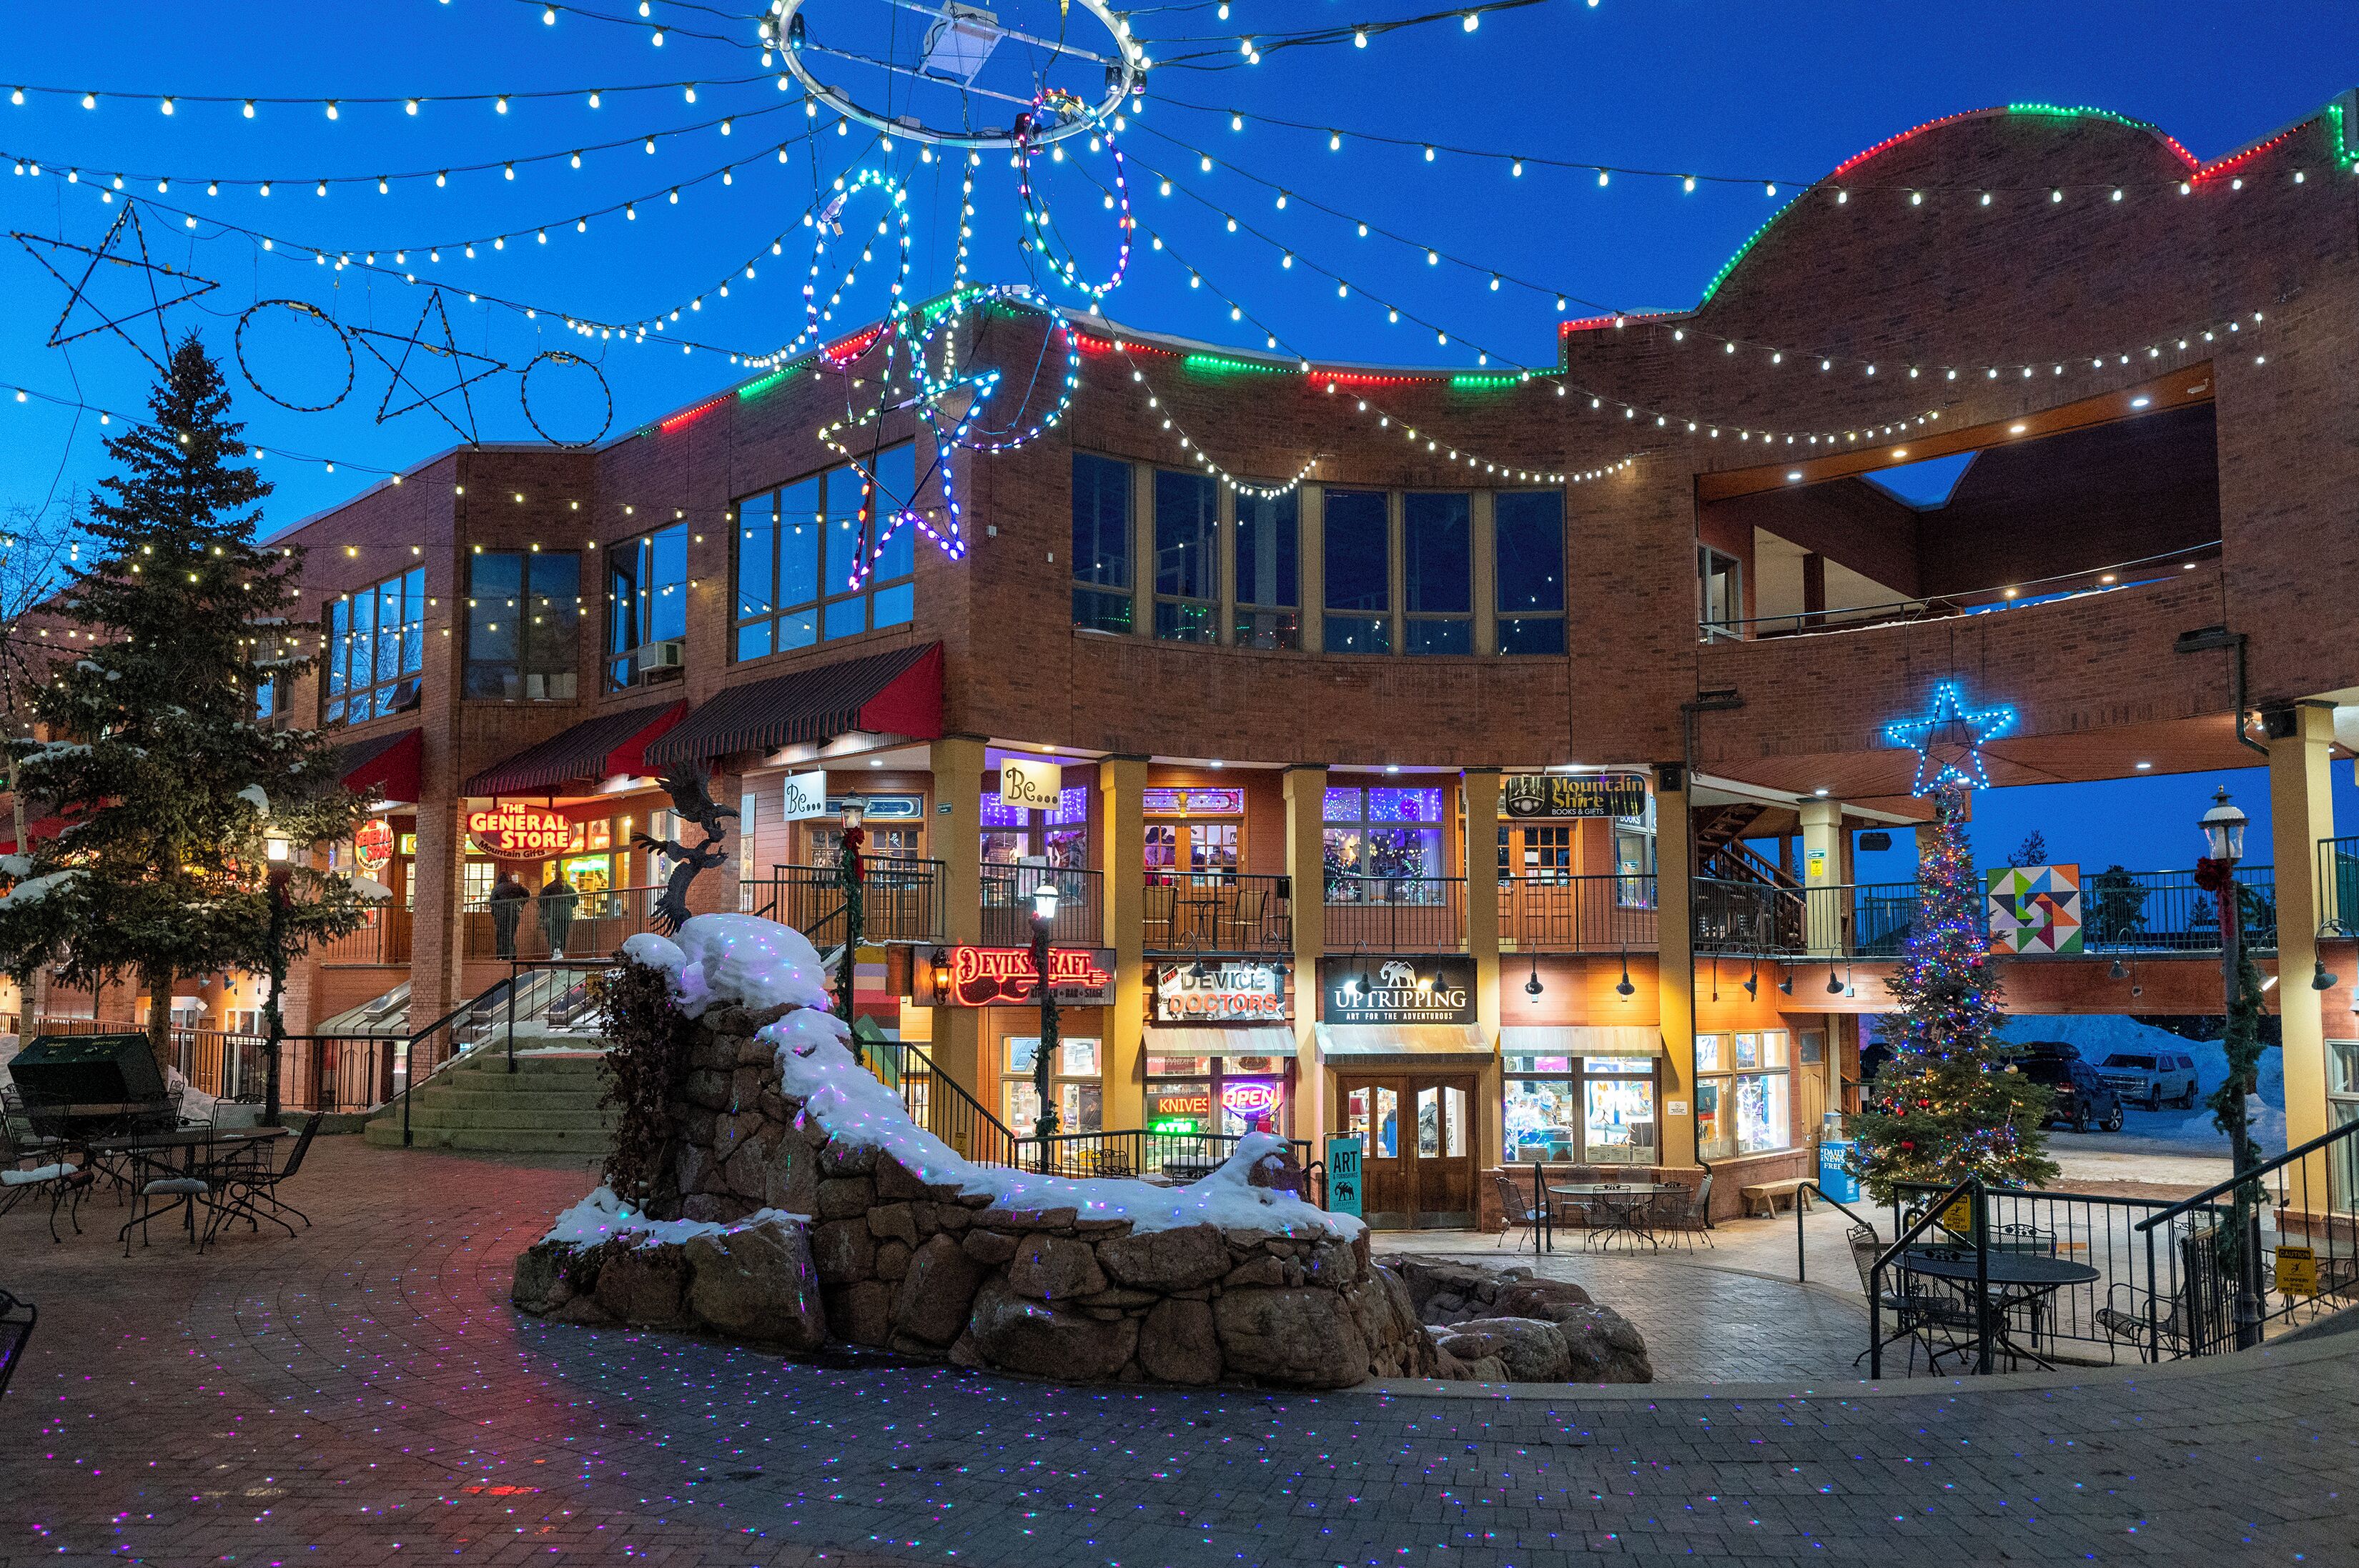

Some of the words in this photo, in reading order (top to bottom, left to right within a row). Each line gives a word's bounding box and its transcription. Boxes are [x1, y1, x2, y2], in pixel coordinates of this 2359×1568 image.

[1006, 767, 1058, 804] Be...
[1552, 777, 1643, 793] Mountain
[786, 783, 821, 813] Be...
[1552, 790, 1604, 808] Shire
[501, 803, 525, 814] THE
[470, 813, 569, 832] GENERAL
[355, 826, 391, 848] GENERAL
[501, 831, 569, 849] STORE
[366, 843, 392, 862] STORE
[478, 840, 520, 858] Mountain
[523, 849, 545, 858] Gifts
[958, 948, 1030, 982] DEVIL'S
[1037, 948, 1091, 975] RAFT
[1162, 967, 1179, 983] THE
[1182, 972, 1266, 990] DEVICE
[1065, 988, 1078, 998] BAR
[1084, 988, 1104, 998] STAGE
[1335, 991, 1467, 1008] UPTRIPPING
[1169, 993, 1277, 1013] DOCTORS
[1159, 1098, 1207, 1113] KNIVES
[1222, 1089, 1275, 1108] OPEN
[1155, 1122, 1192, 1132] ATM
[1333, 1151, 1357, 1172] ART
[1824, 1148, 1845, 1157] DAILY
[1824, 1155, 1845, 1163] NEWS
[2280, 1249, 2310, 1259] CAUTION
